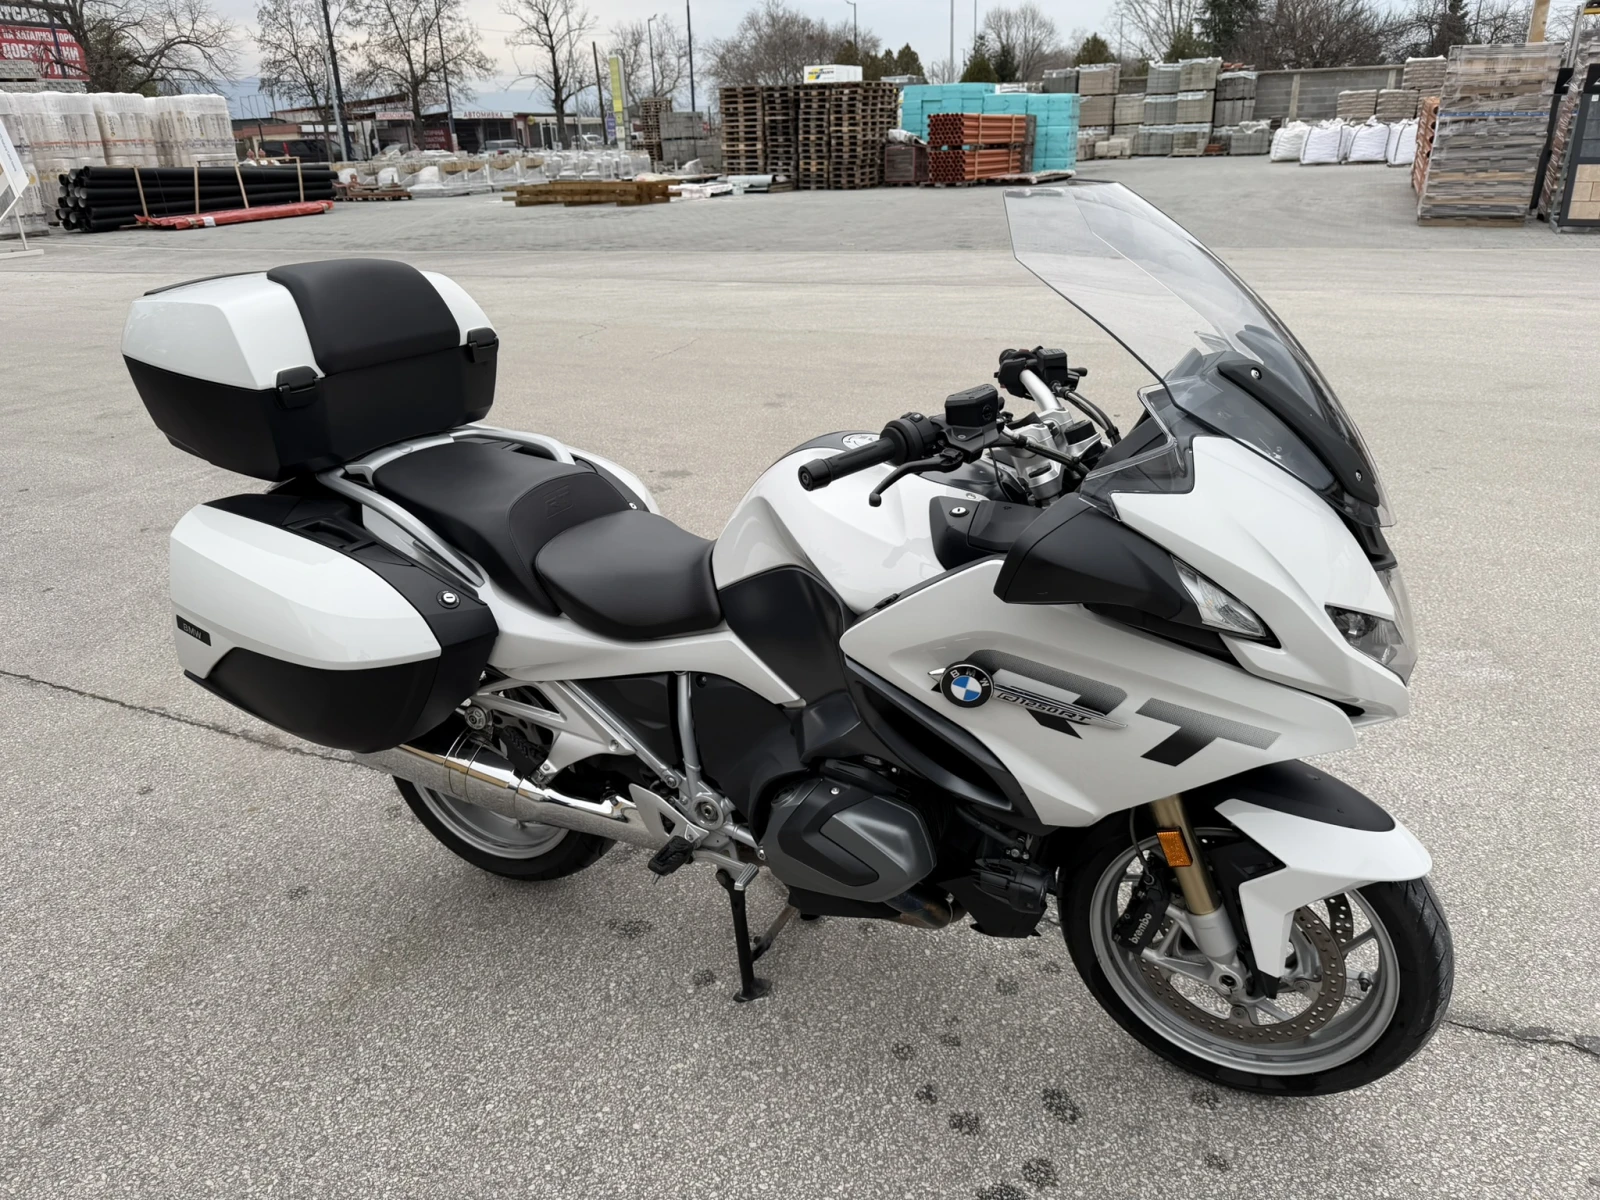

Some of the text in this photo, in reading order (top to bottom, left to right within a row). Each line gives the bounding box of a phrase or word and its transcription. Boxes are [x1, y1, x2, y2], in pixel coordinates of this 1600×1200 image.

[463, 111, 505, 119] АВТОМИВКА
[182, 622, 202, 640] BMW
[950, 667, 990, 688] BMW
[1128, 912, 1152, 945] brembo
